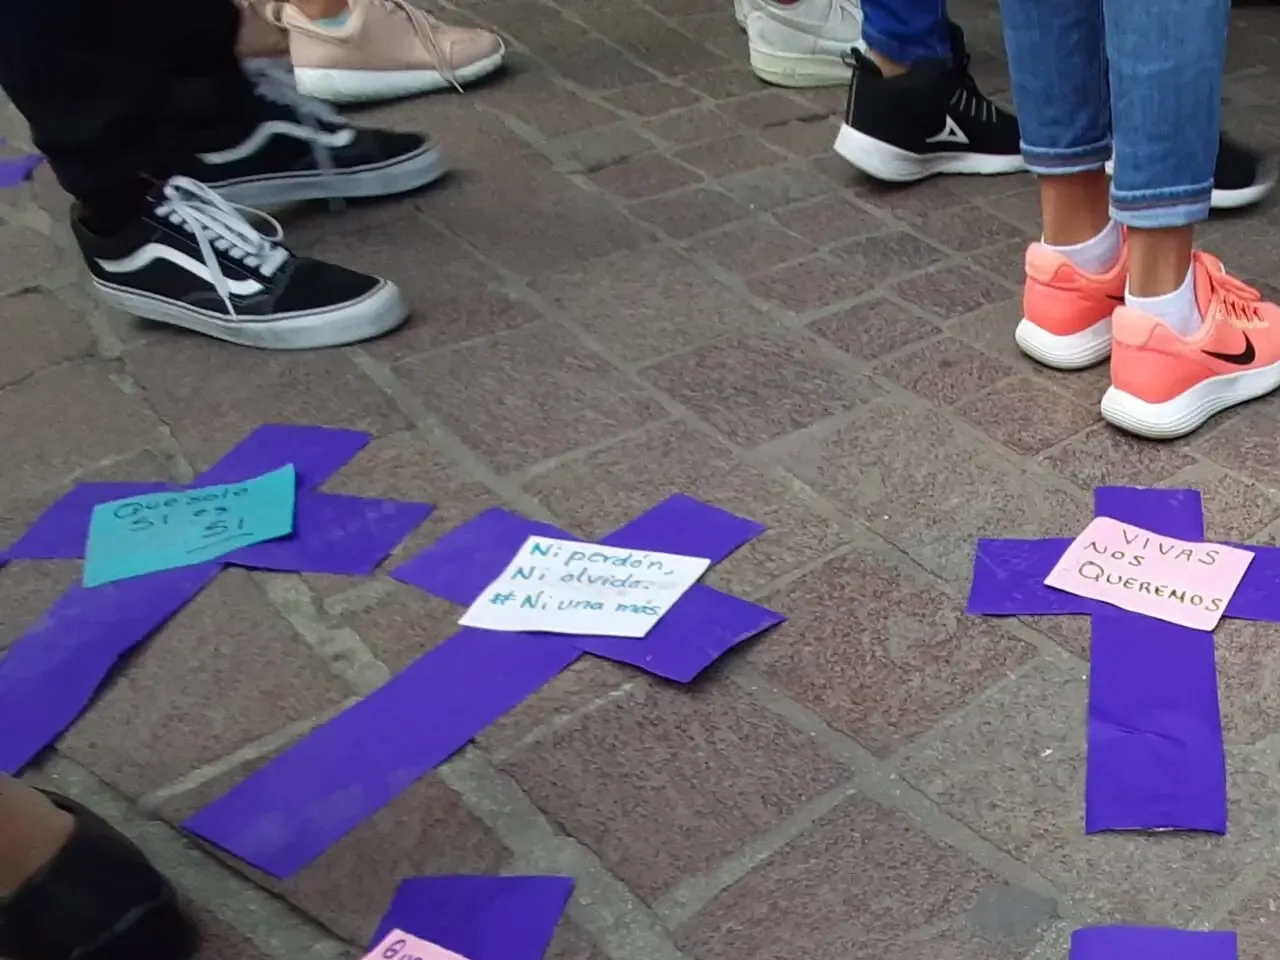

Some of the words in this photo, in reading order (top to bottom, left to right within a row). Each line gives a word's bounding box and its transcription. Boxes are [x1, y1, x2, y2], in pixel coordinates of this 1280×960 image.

[529, 542, 564, 557] Ni
[1083, 541, 1146, 567] NOS
[1122, 529, 1220, 566] VIVAS
[511, 566, 549, 581] Ni
[1078, 561, 1224, 613] QUEREMOS
[557, 599, 605, 611] una
